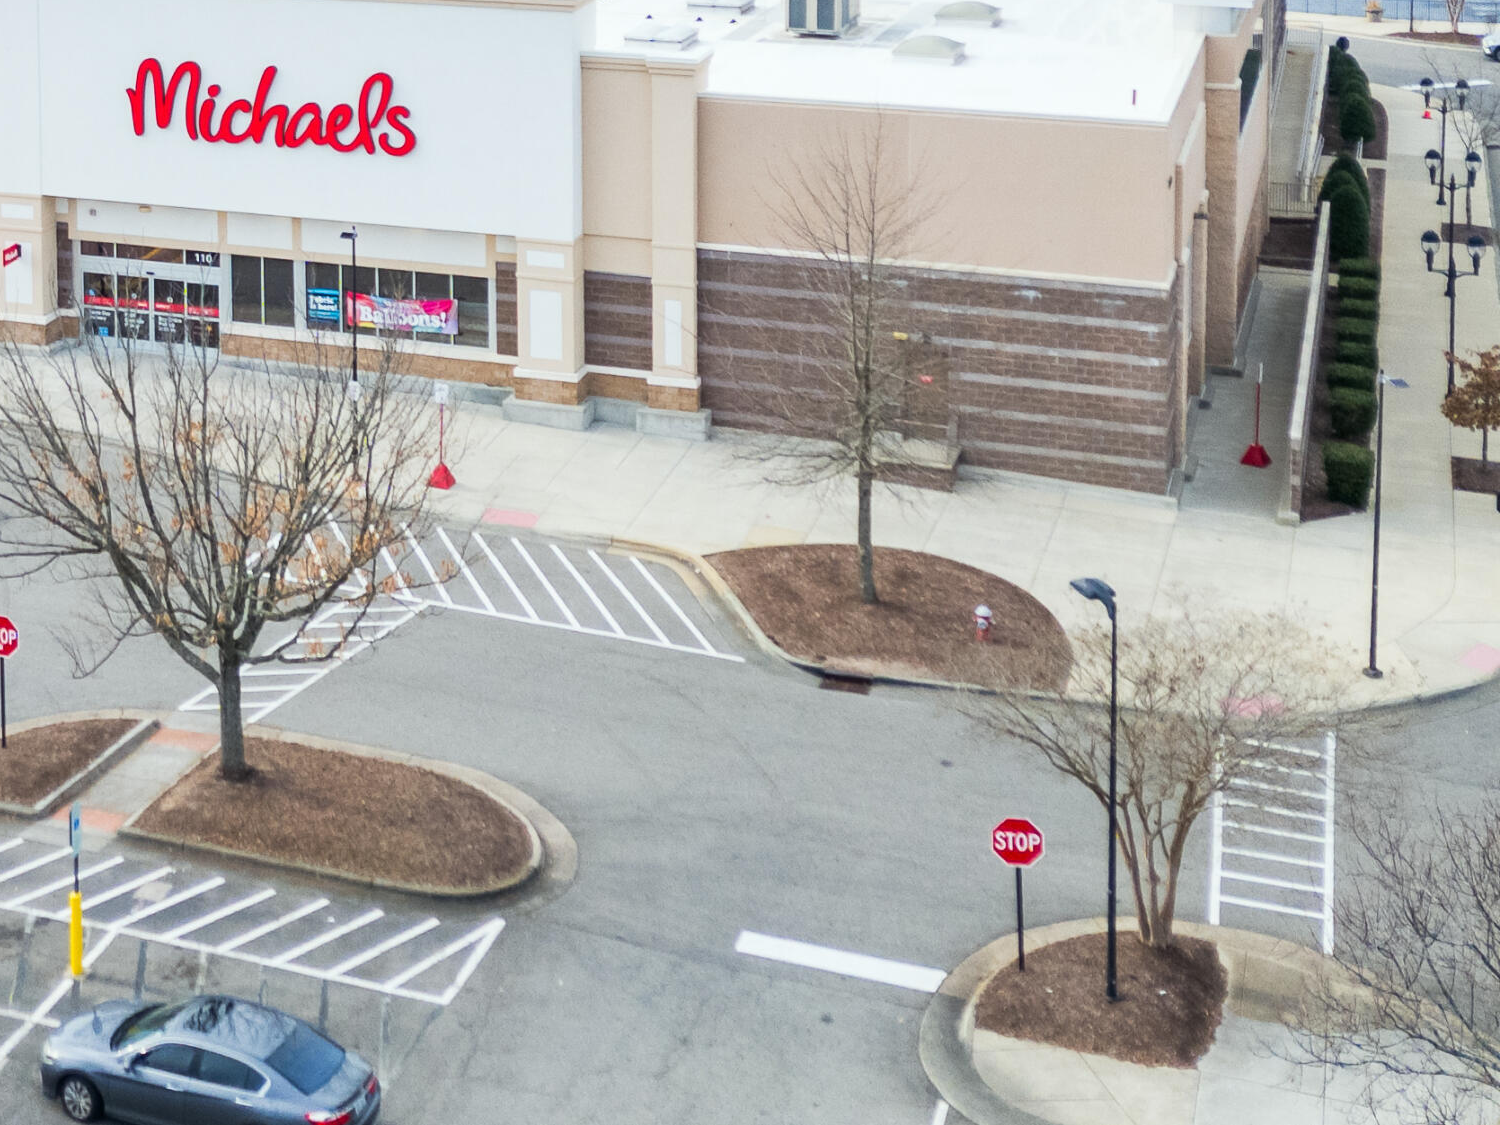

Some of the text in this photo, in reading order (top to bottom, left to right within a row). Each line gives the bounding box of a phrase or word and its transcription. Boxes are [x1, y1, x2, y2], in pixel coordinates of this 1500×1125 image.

[125, 58, 417, 157] Michaels
[194, 253, 213, 264] 110
[995, 830, 1041, 852] STOP
